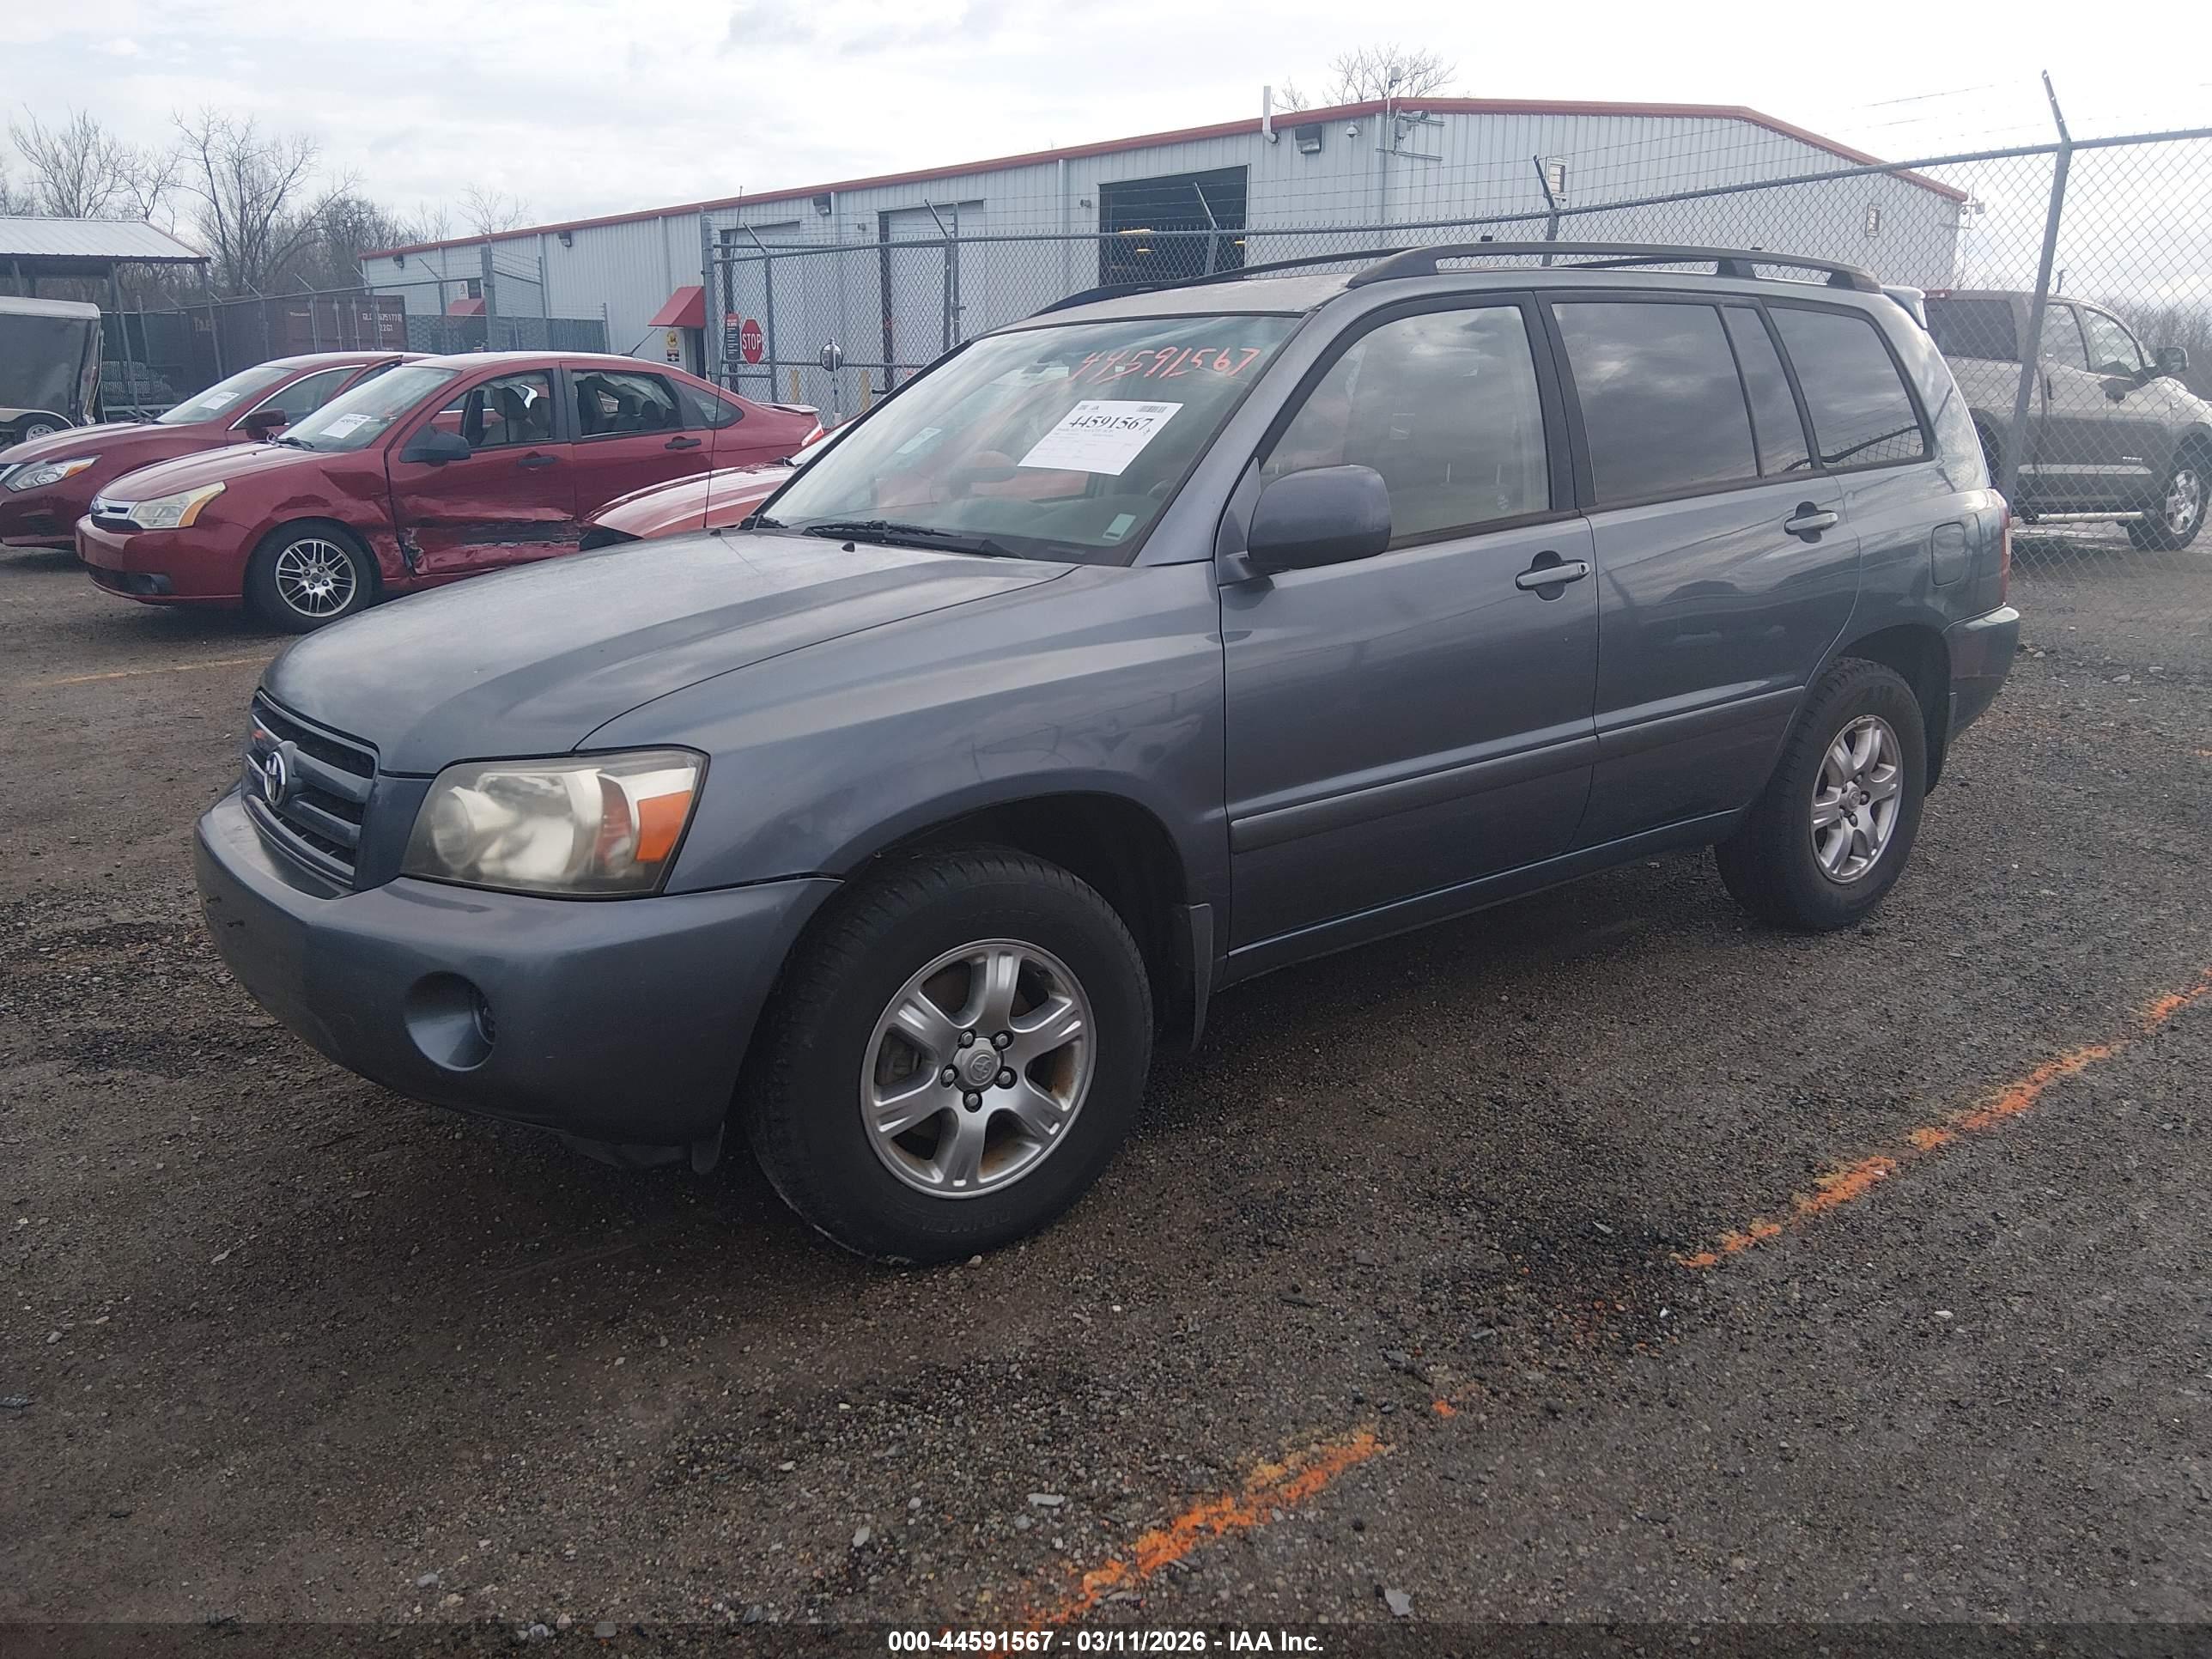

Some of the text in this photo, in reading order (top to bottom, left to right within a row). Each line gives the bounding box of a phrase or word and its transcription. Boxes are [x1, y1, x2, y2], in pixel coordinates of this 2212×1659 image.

[742, 333, 762, 350] STOP
[1068, 347, 1261, 385] 44591567
[1069, 416, 1155, 430] 44591567
